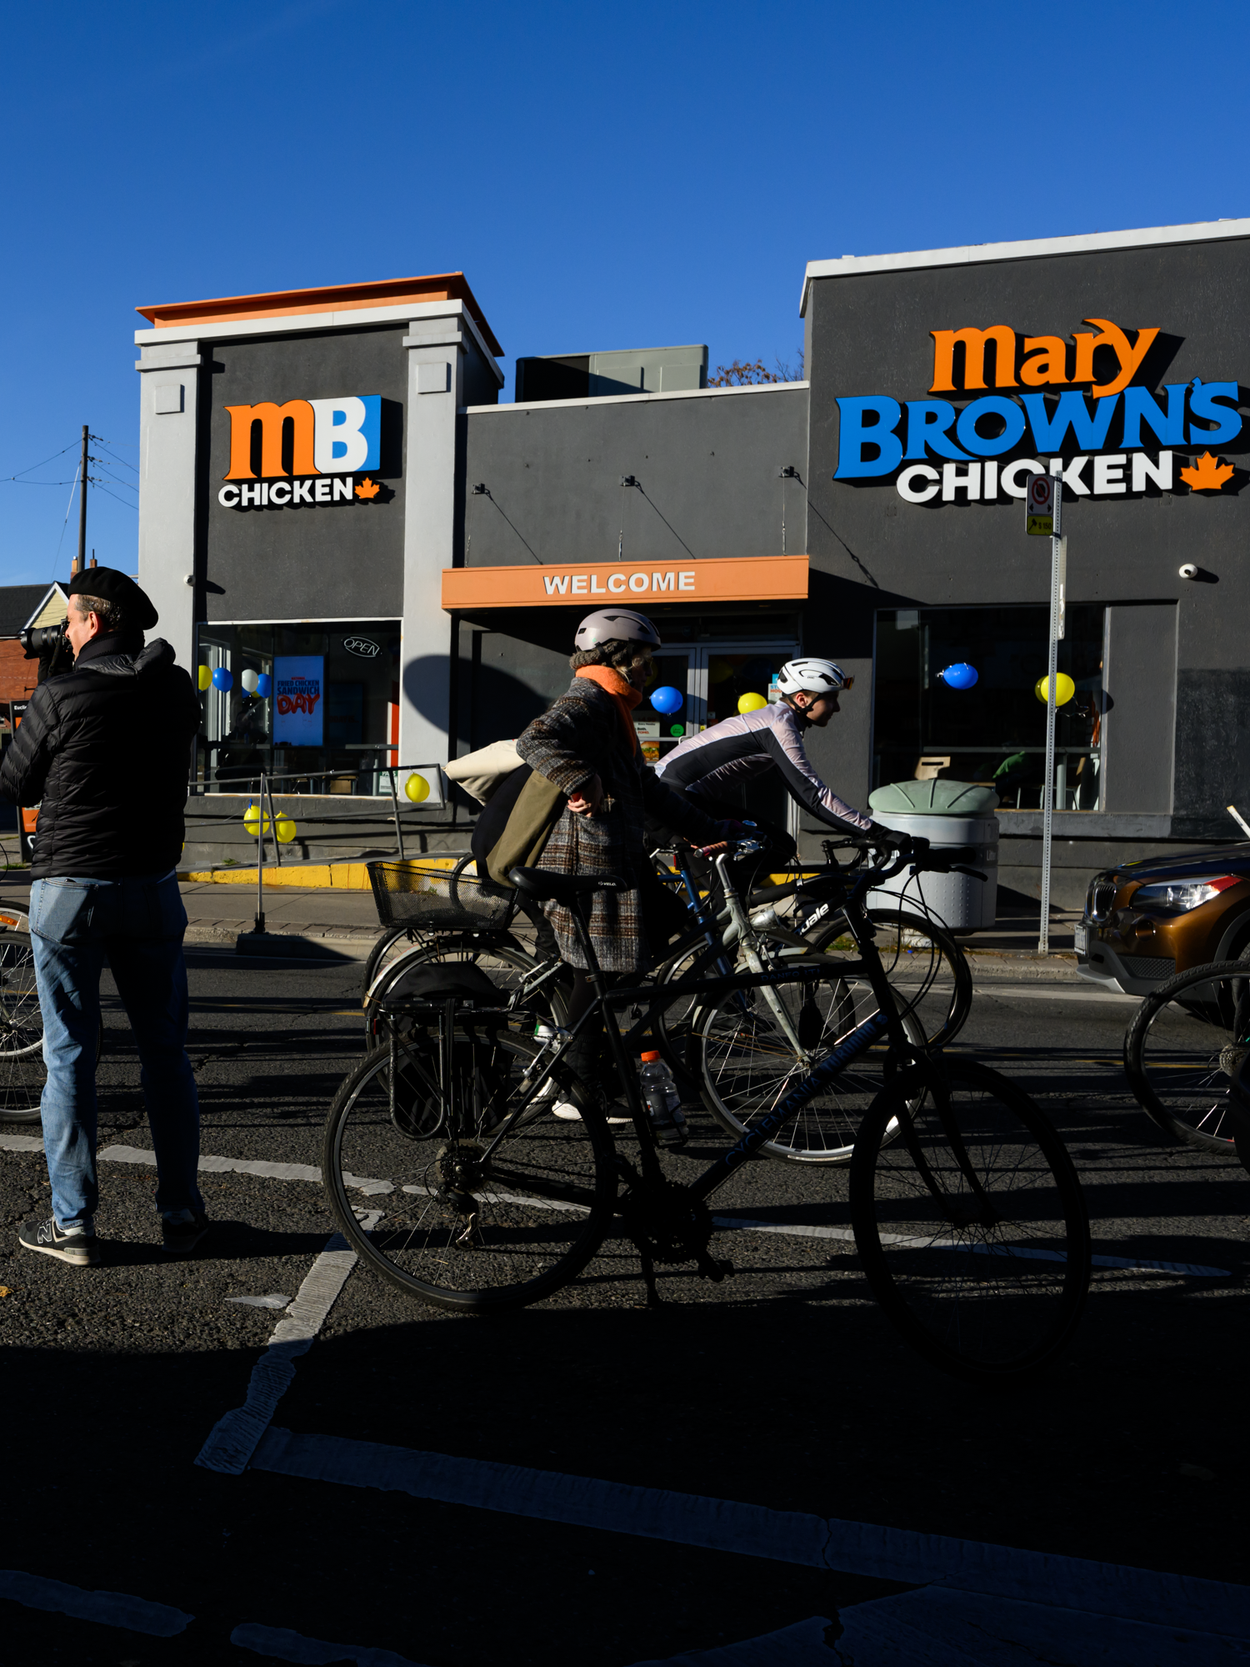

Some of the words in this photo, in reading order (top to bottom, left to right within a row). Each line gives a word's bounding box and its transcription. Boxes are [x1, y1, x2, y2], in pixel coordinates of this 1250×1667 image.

[928, 318, 1161, 398] mary
[833, 376, 1243, 480] BROWN'S
[896, 449, 1173, 504] CHICKEN
[218, 477, 355, 508] CHICKEN
[543, 571, 696, 595] WELCOME
[343, 638, 380, 657] OPEN
[276, 693, 321, 716] DAY
[277, 686, 320, 695] SANDWICH
[724, 1076, 827, 1168] CYCLEMANIA
